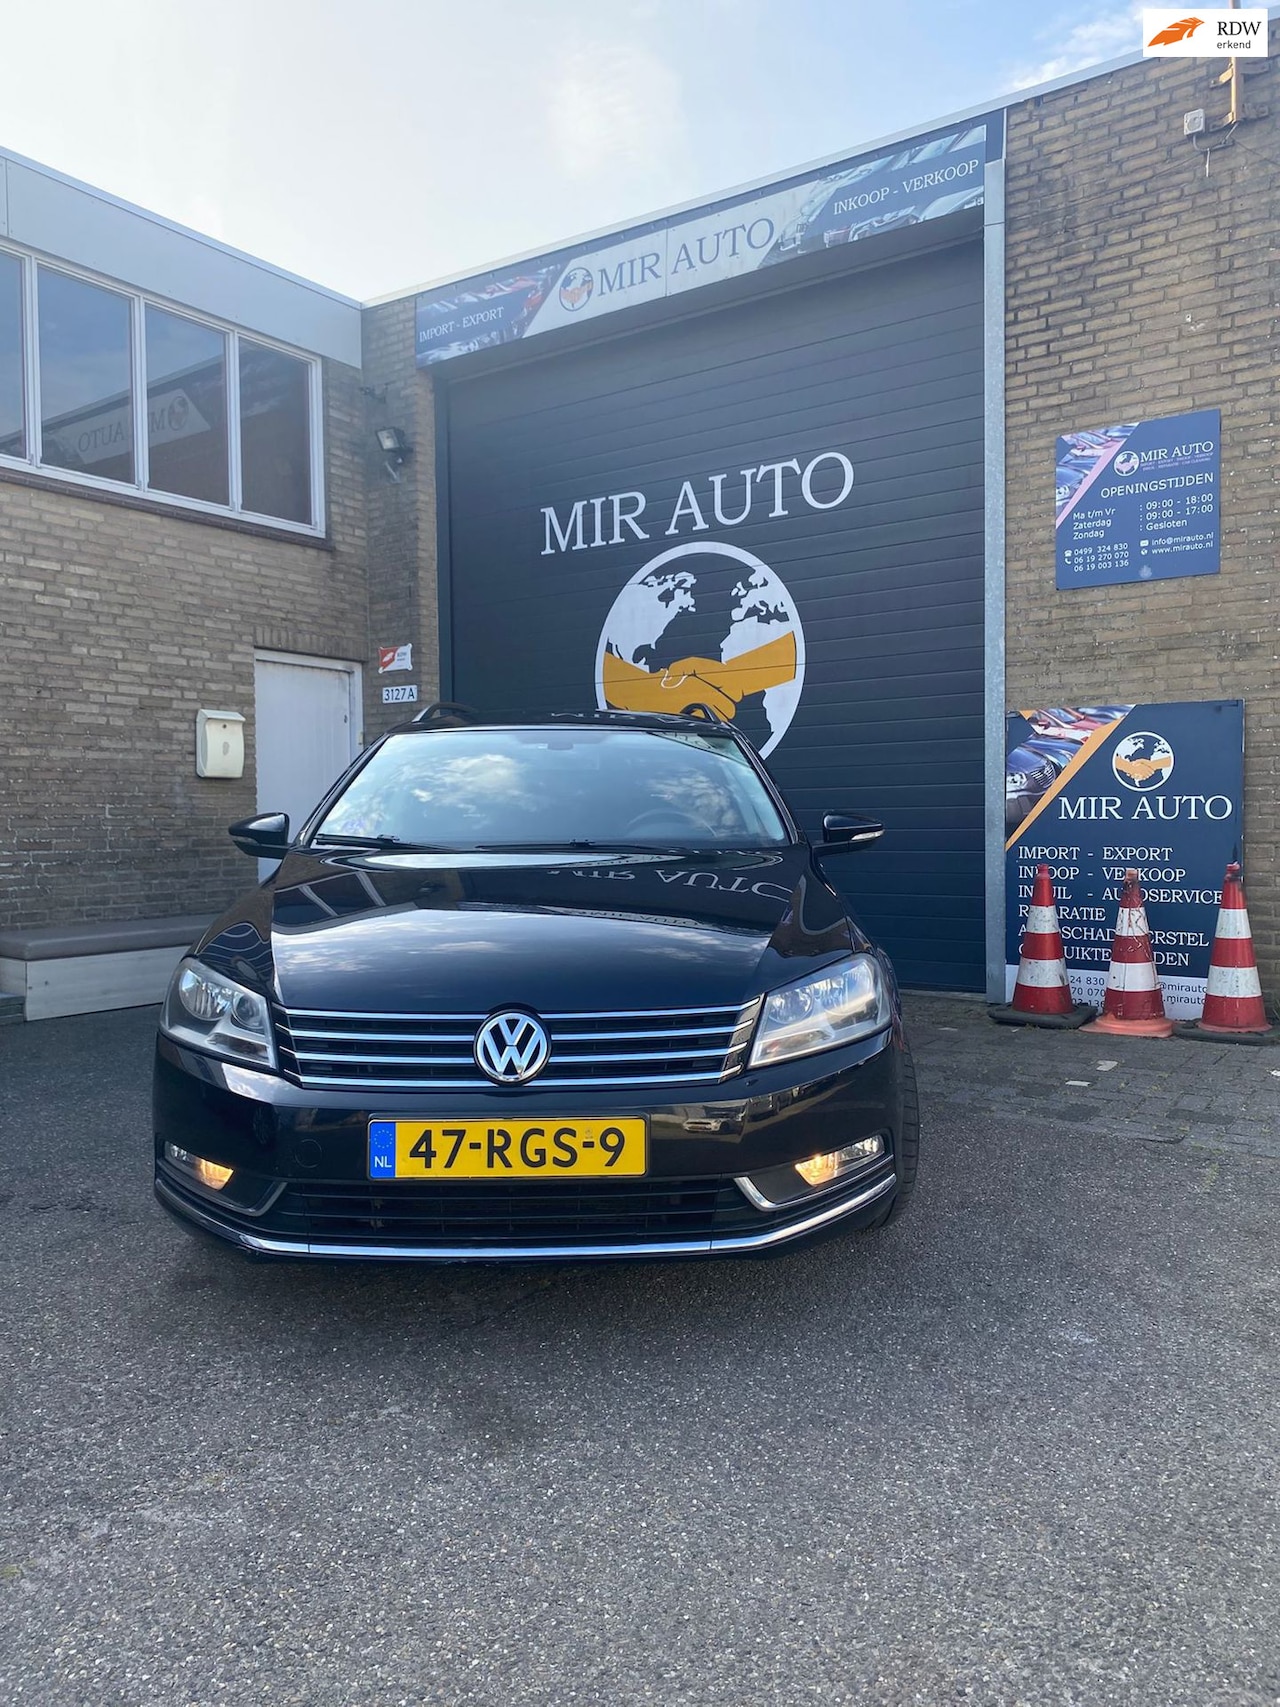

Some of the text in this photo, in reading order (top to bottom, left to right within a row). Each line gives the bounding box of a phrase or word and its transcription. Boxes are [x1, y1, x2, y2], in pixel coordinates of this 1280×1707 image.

[833, 187, 890, 215] INKOOP
[902, 159, 979, 193] VERKOOP
[597, 218, 775, 297] MIR AUTO
[419, 321, 455, 343] IMPORT
[462, 306, 504, 328] EXPORT
[1140, 448, 1168, 463] MIR
[1171, 440, 1214, 458] AUTO
[1101, 472, 1214, 499] OPENINGSTIJDEN
[540, 452, 854, 555] MIR AUTO
[1073, 512, 1085, 520] Ma
[1087, 510, 1103, 519] t/m
[1105, 508, 1116, 516] Vr
[1146, 499, 1173, 510] 09:00
[1186, 493, 1213, 504] 18:00
[1073, 519, 1112, 530] Zaterdag
[1146, 509, 1173, 520] 09:00
[1186, 504, 1213, 515] 17:00
[1073, 530, 1105, 540] Zondag
[1146, 520, 1187, 531] Gesloten
[1151, 532, 1214, 545] info@mirauto.nl
[1074, 556, 1084, 564] 06
[1098, 553, 1112, 561] 270
[1114, 551, 1129, 559] 070
[1097, 545, 1111, 553] 324
[1113, 542, 1128, 551] 830
[1151, 541, 1213, 554] www.mirauto.nl
[1097, 561, 1112, 569] 003
[1115, 559, 1129, 567] 136
[1058, 795, 1233, 820] MIR AUTO
[1018, 846, 1080, 860] IMPORT
[1102, 846, 1173, 861] EXPORT
[1018, 865, 1080, 880] INOOP
[1102, 867, 1186, 882] VEKOOP
[1102, 887, 1223, 905] AUOSERVICE
[1086, 976, 1105, 986] 830
[477, 1012, 548, 1082] VW
[374, 1127, 625, 1168] NL 47-RGS-9
